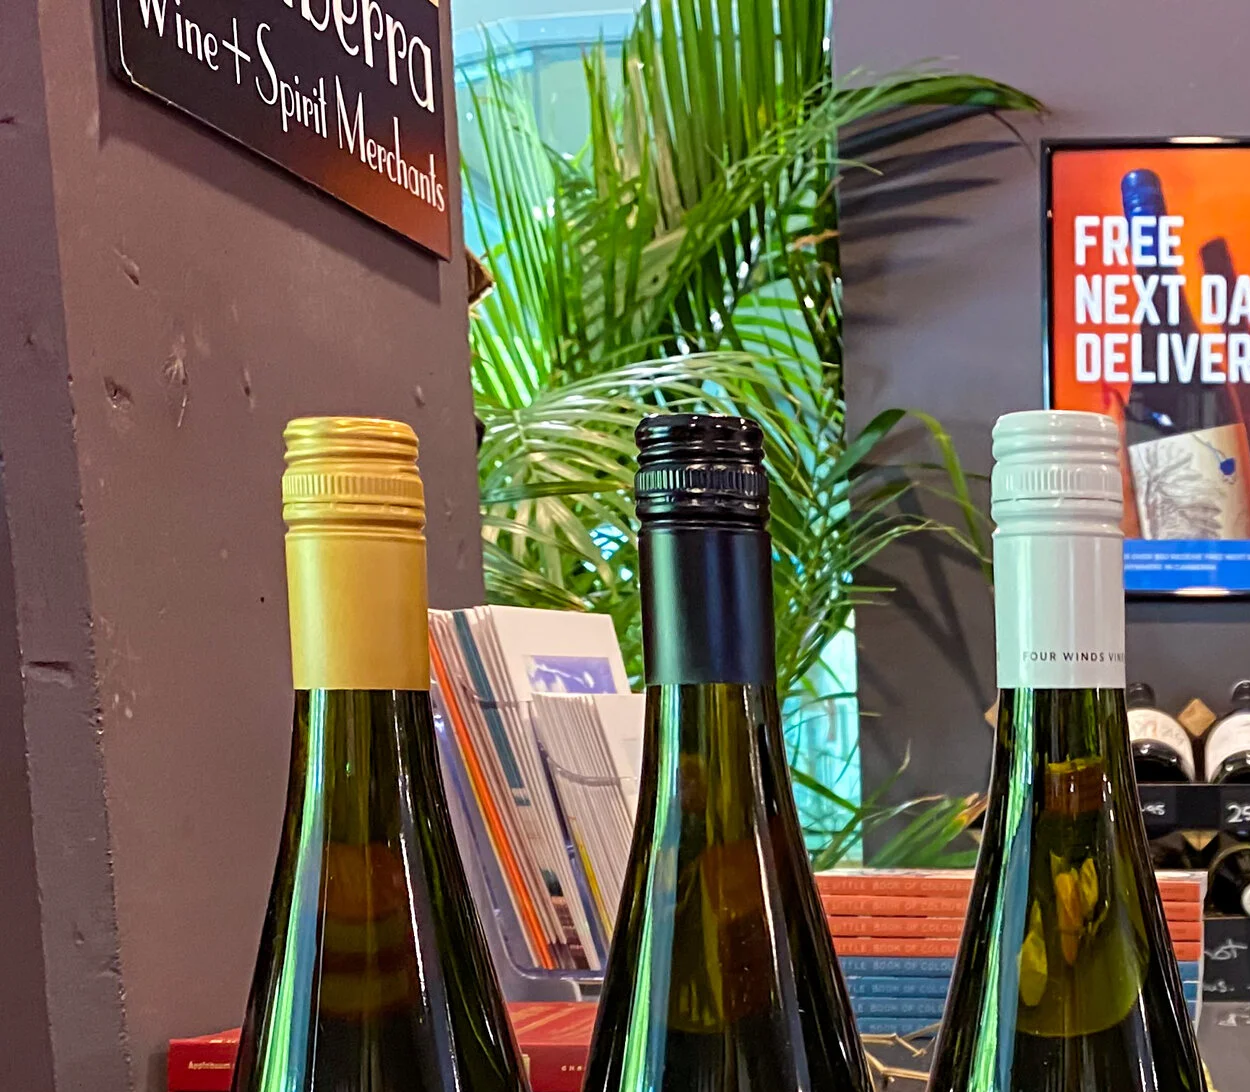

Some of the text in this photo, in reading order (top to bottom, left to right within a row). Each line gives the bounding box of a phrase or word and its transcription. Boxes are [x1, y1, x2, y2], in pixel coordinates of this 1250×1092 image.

[255, 22, 328, 138] Spirit
[335, 75, 446, 212] Merchants
[1074, 215, 1184, 267] FREE
[1075, 274, 1186, 325] NEXT
[1023, 652, 1057, 662] FOUR
[1063, 652, 1106, 662] WINDS
